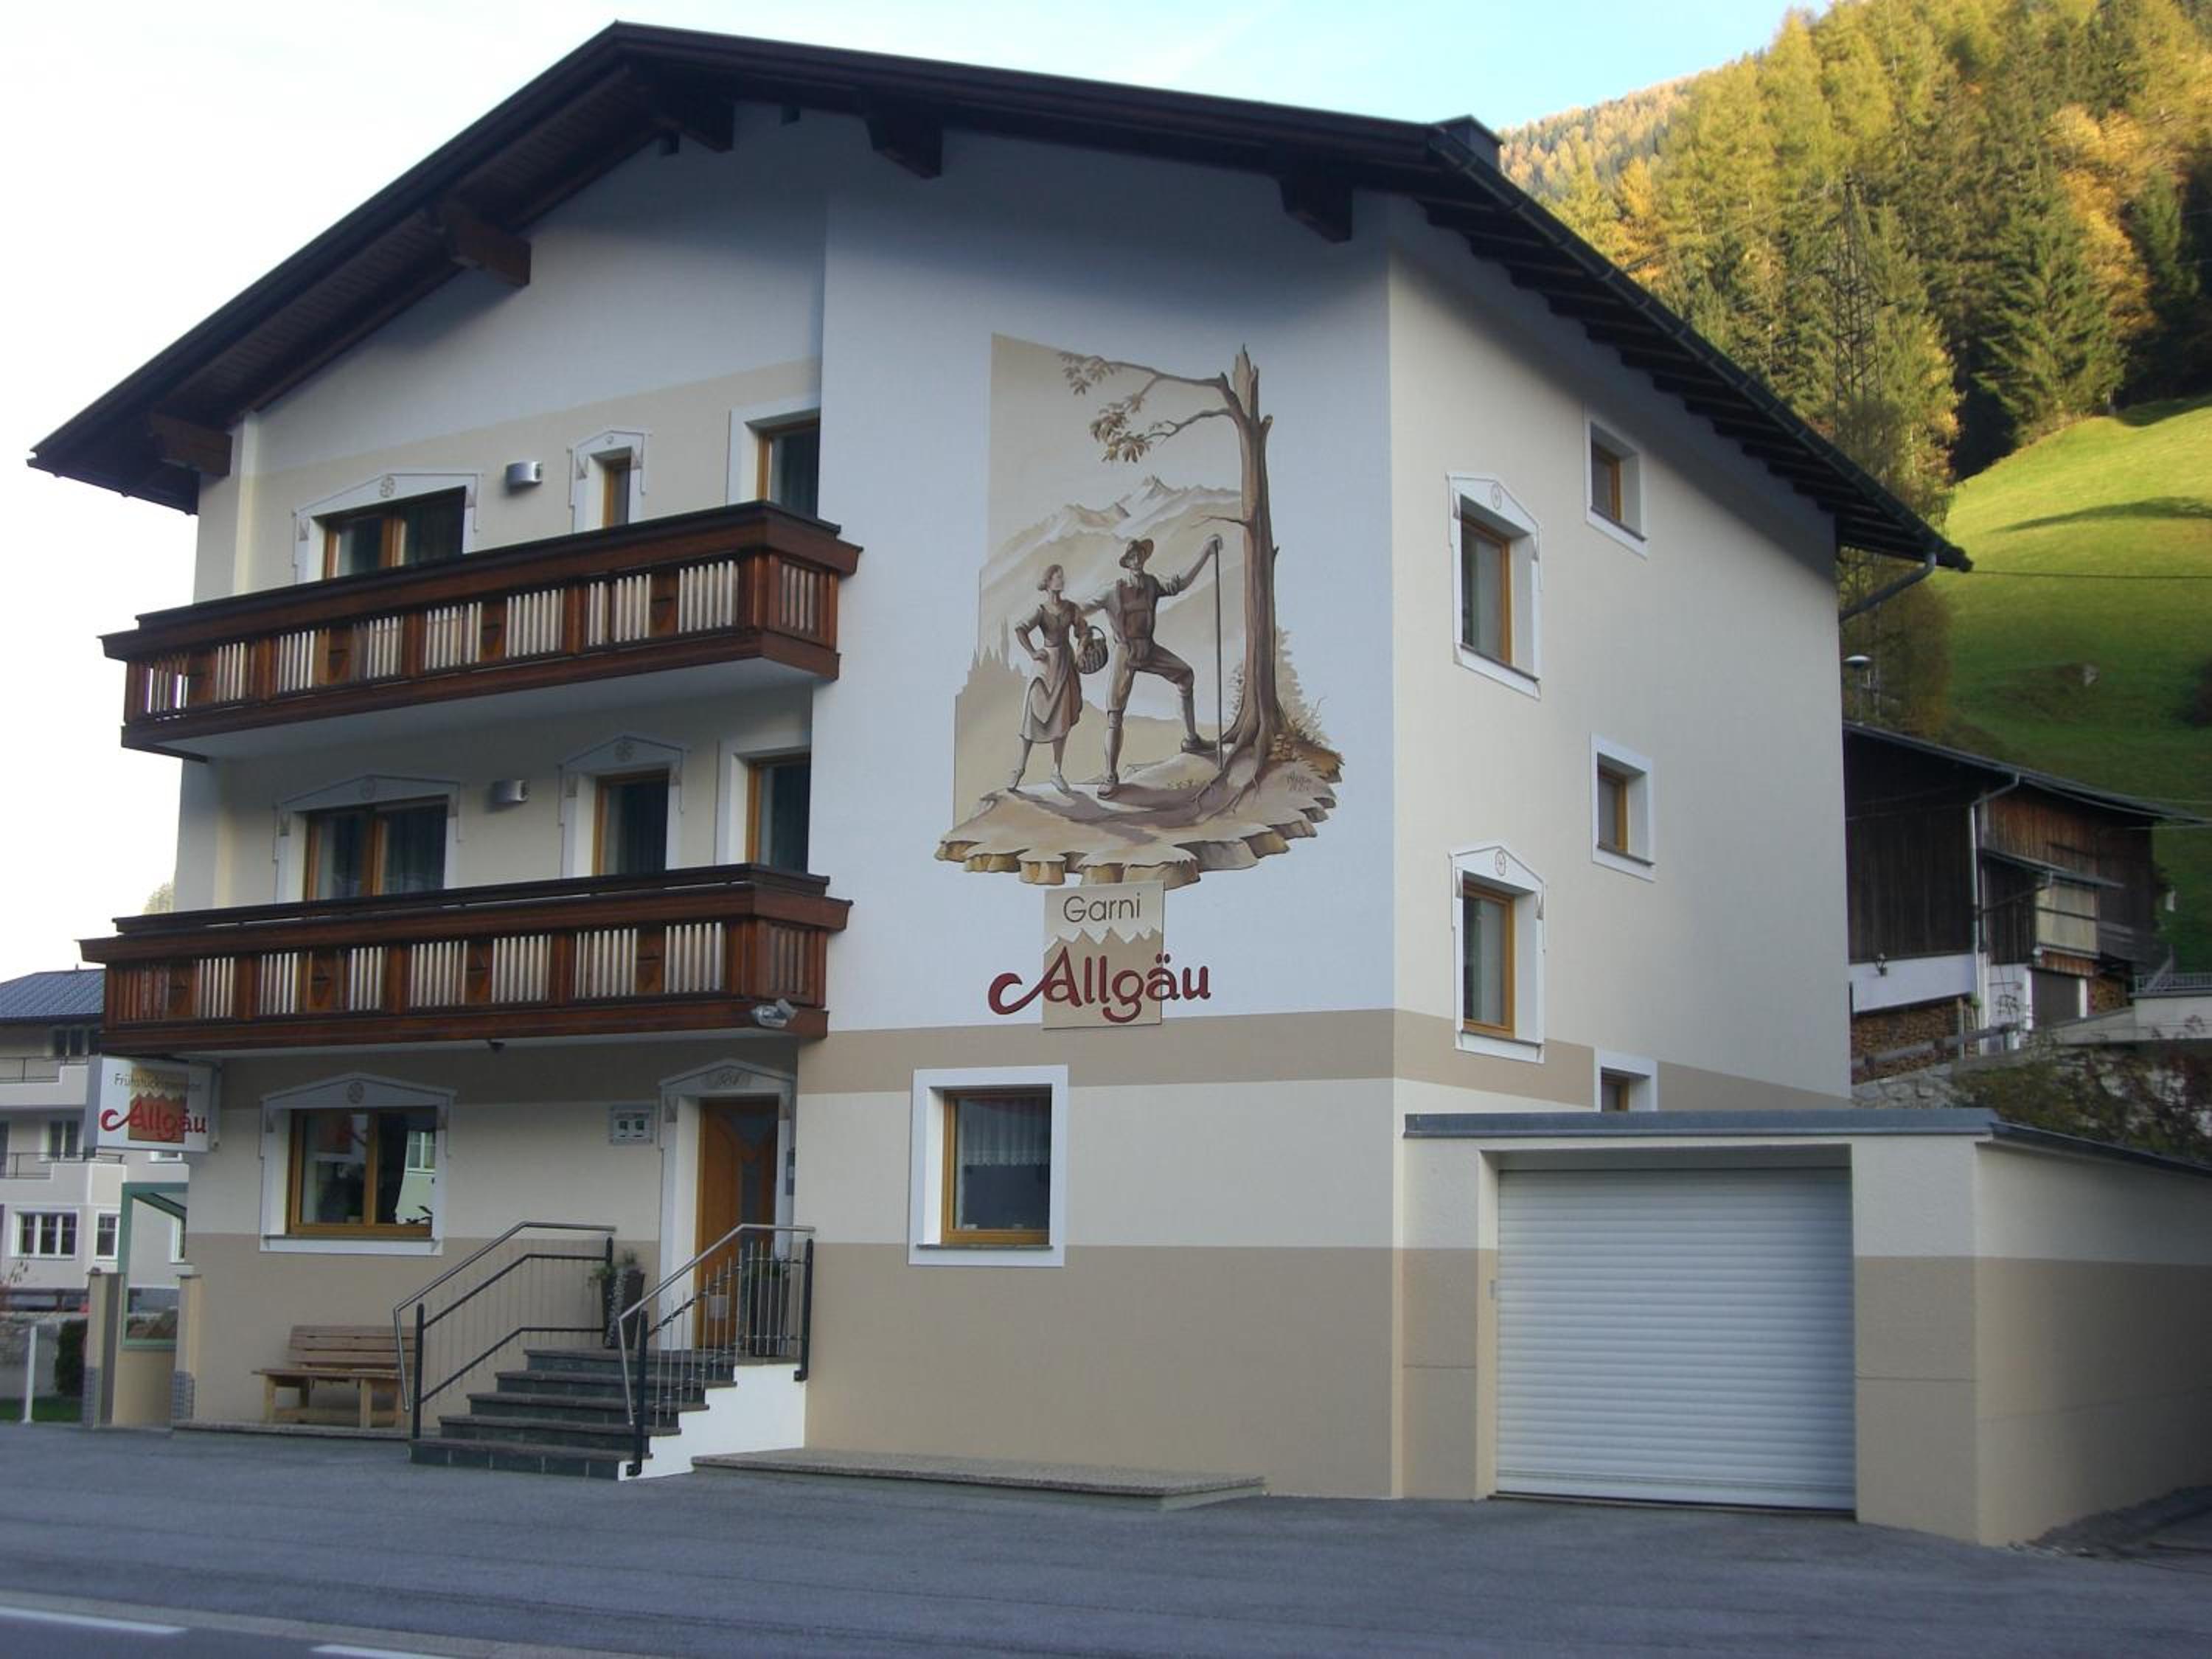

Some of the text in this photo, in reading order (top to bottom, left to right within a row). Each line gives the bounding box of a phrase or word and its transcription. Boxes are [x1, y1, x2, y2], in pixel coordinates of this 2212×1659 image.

[1062, 892, 1141, 923] Garni
[987, 945, 1211, 1023] Allgäu
[101, 1098, 207, 1140] Allgäu
